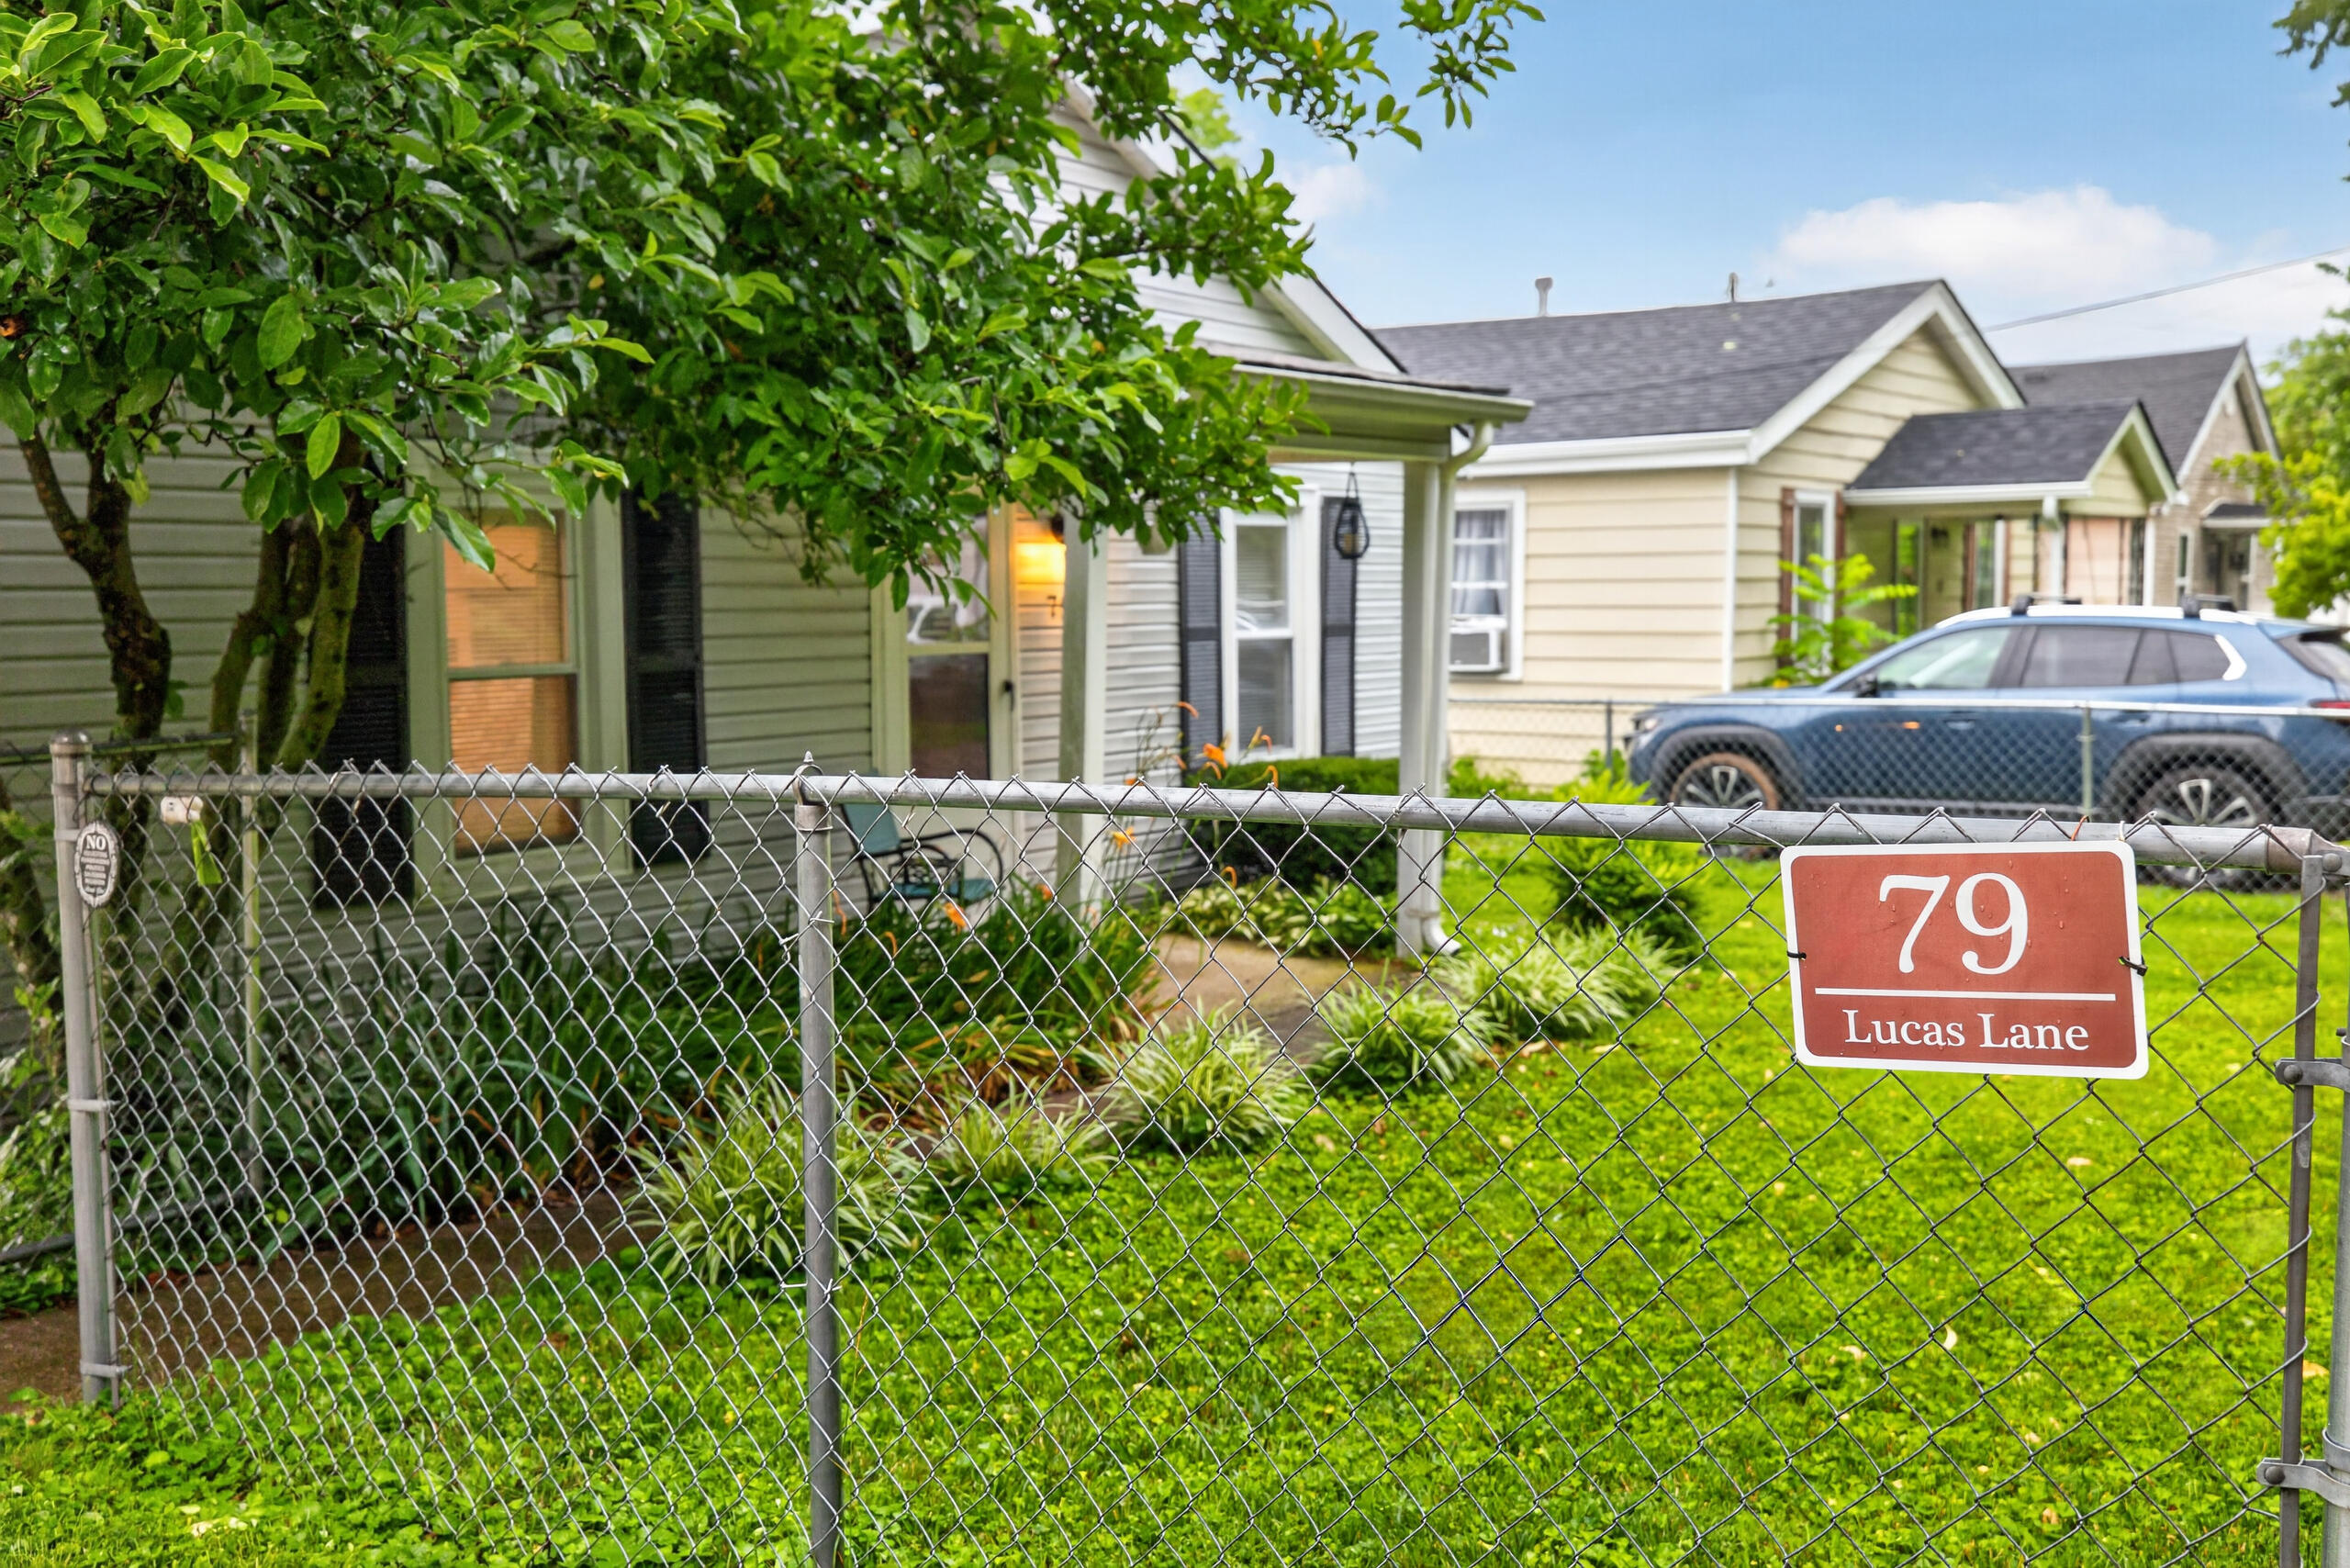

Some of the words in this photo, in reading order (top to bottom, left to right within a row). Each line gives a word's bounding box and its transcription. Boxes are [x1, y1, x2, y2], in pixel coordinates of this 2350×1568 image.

[86, 834, 106, 850] NO
[1879, 872, 2028, 975] 79
[1841, 1009, 1965, 1047] Lucas
[1976, 1013, 2089, 1052] Lane
